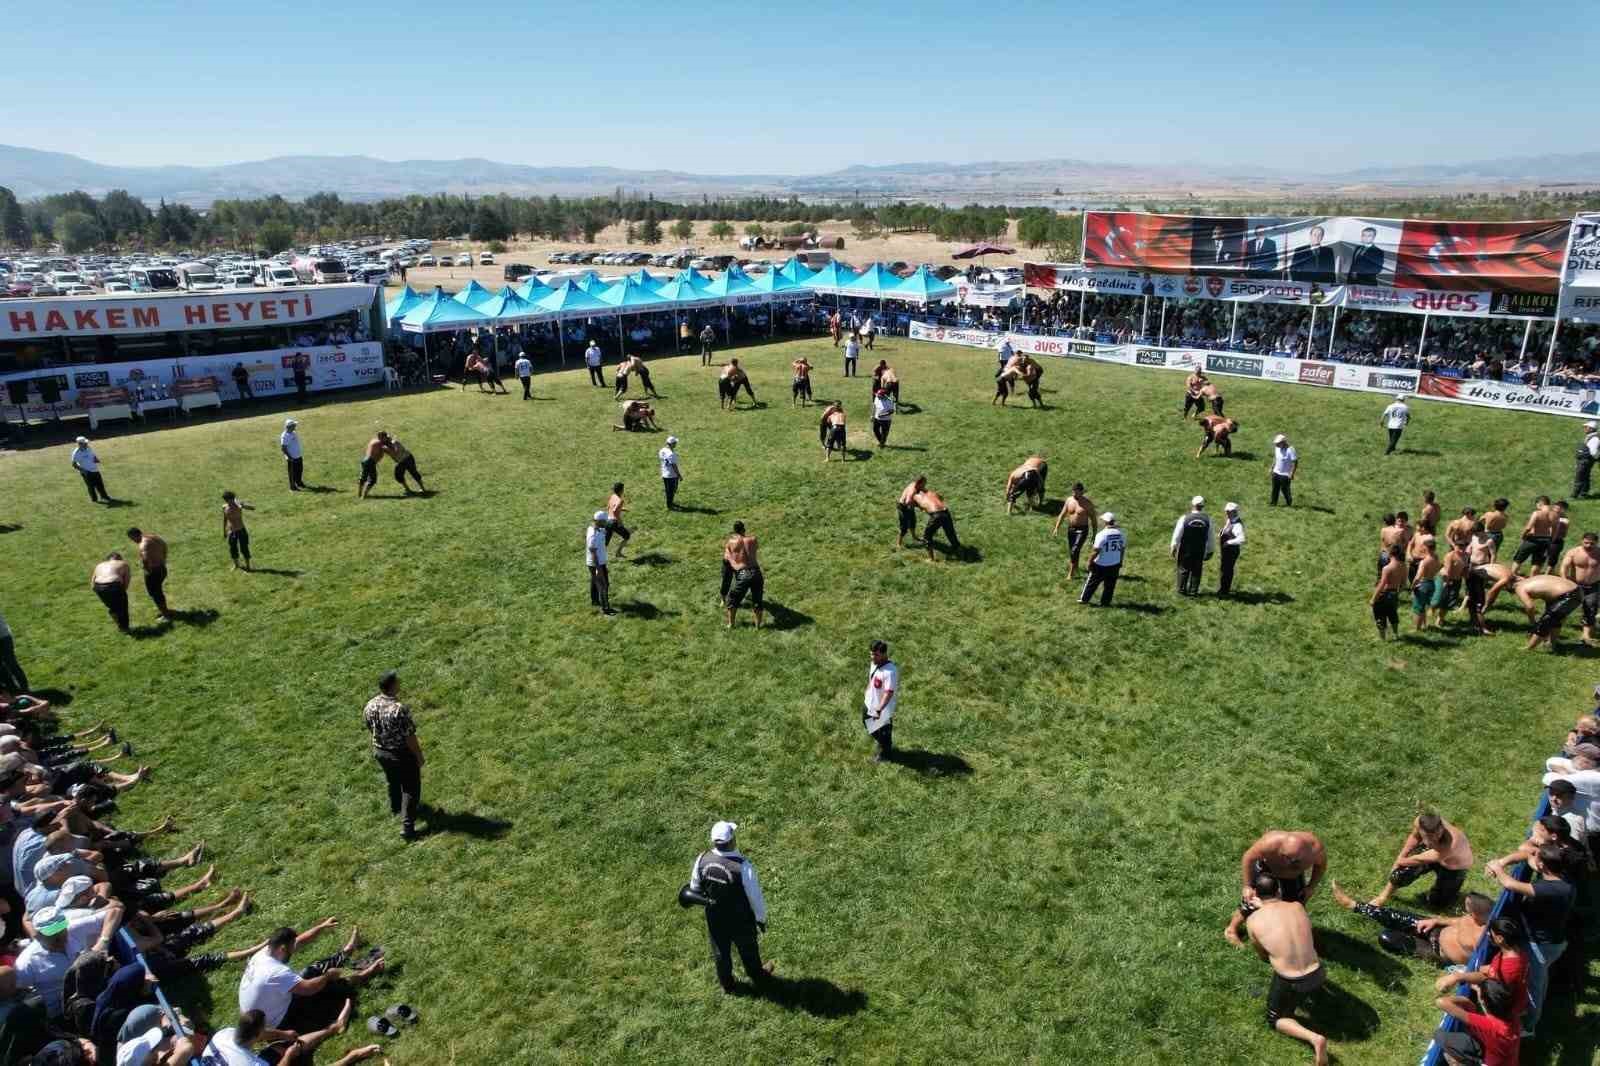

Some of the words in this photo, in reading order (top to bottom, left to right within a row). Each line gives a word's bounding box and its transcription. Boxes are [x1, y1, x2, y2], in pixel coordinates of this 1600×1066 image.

[1088, 278, 1136, 290] Geldiniz
[1412, 292, 1478, 312] aves
[9, 307, 159, 331] HAKEM
[184, 294, 313, 325] HEYETİ
[1034, 341, 1063, 354] aves
[1207, 355, 1262, 371] TAHZEN
[1302, 367, 1333, 379] zafer
[1506, 391, 1573, 408] Geldiniz
